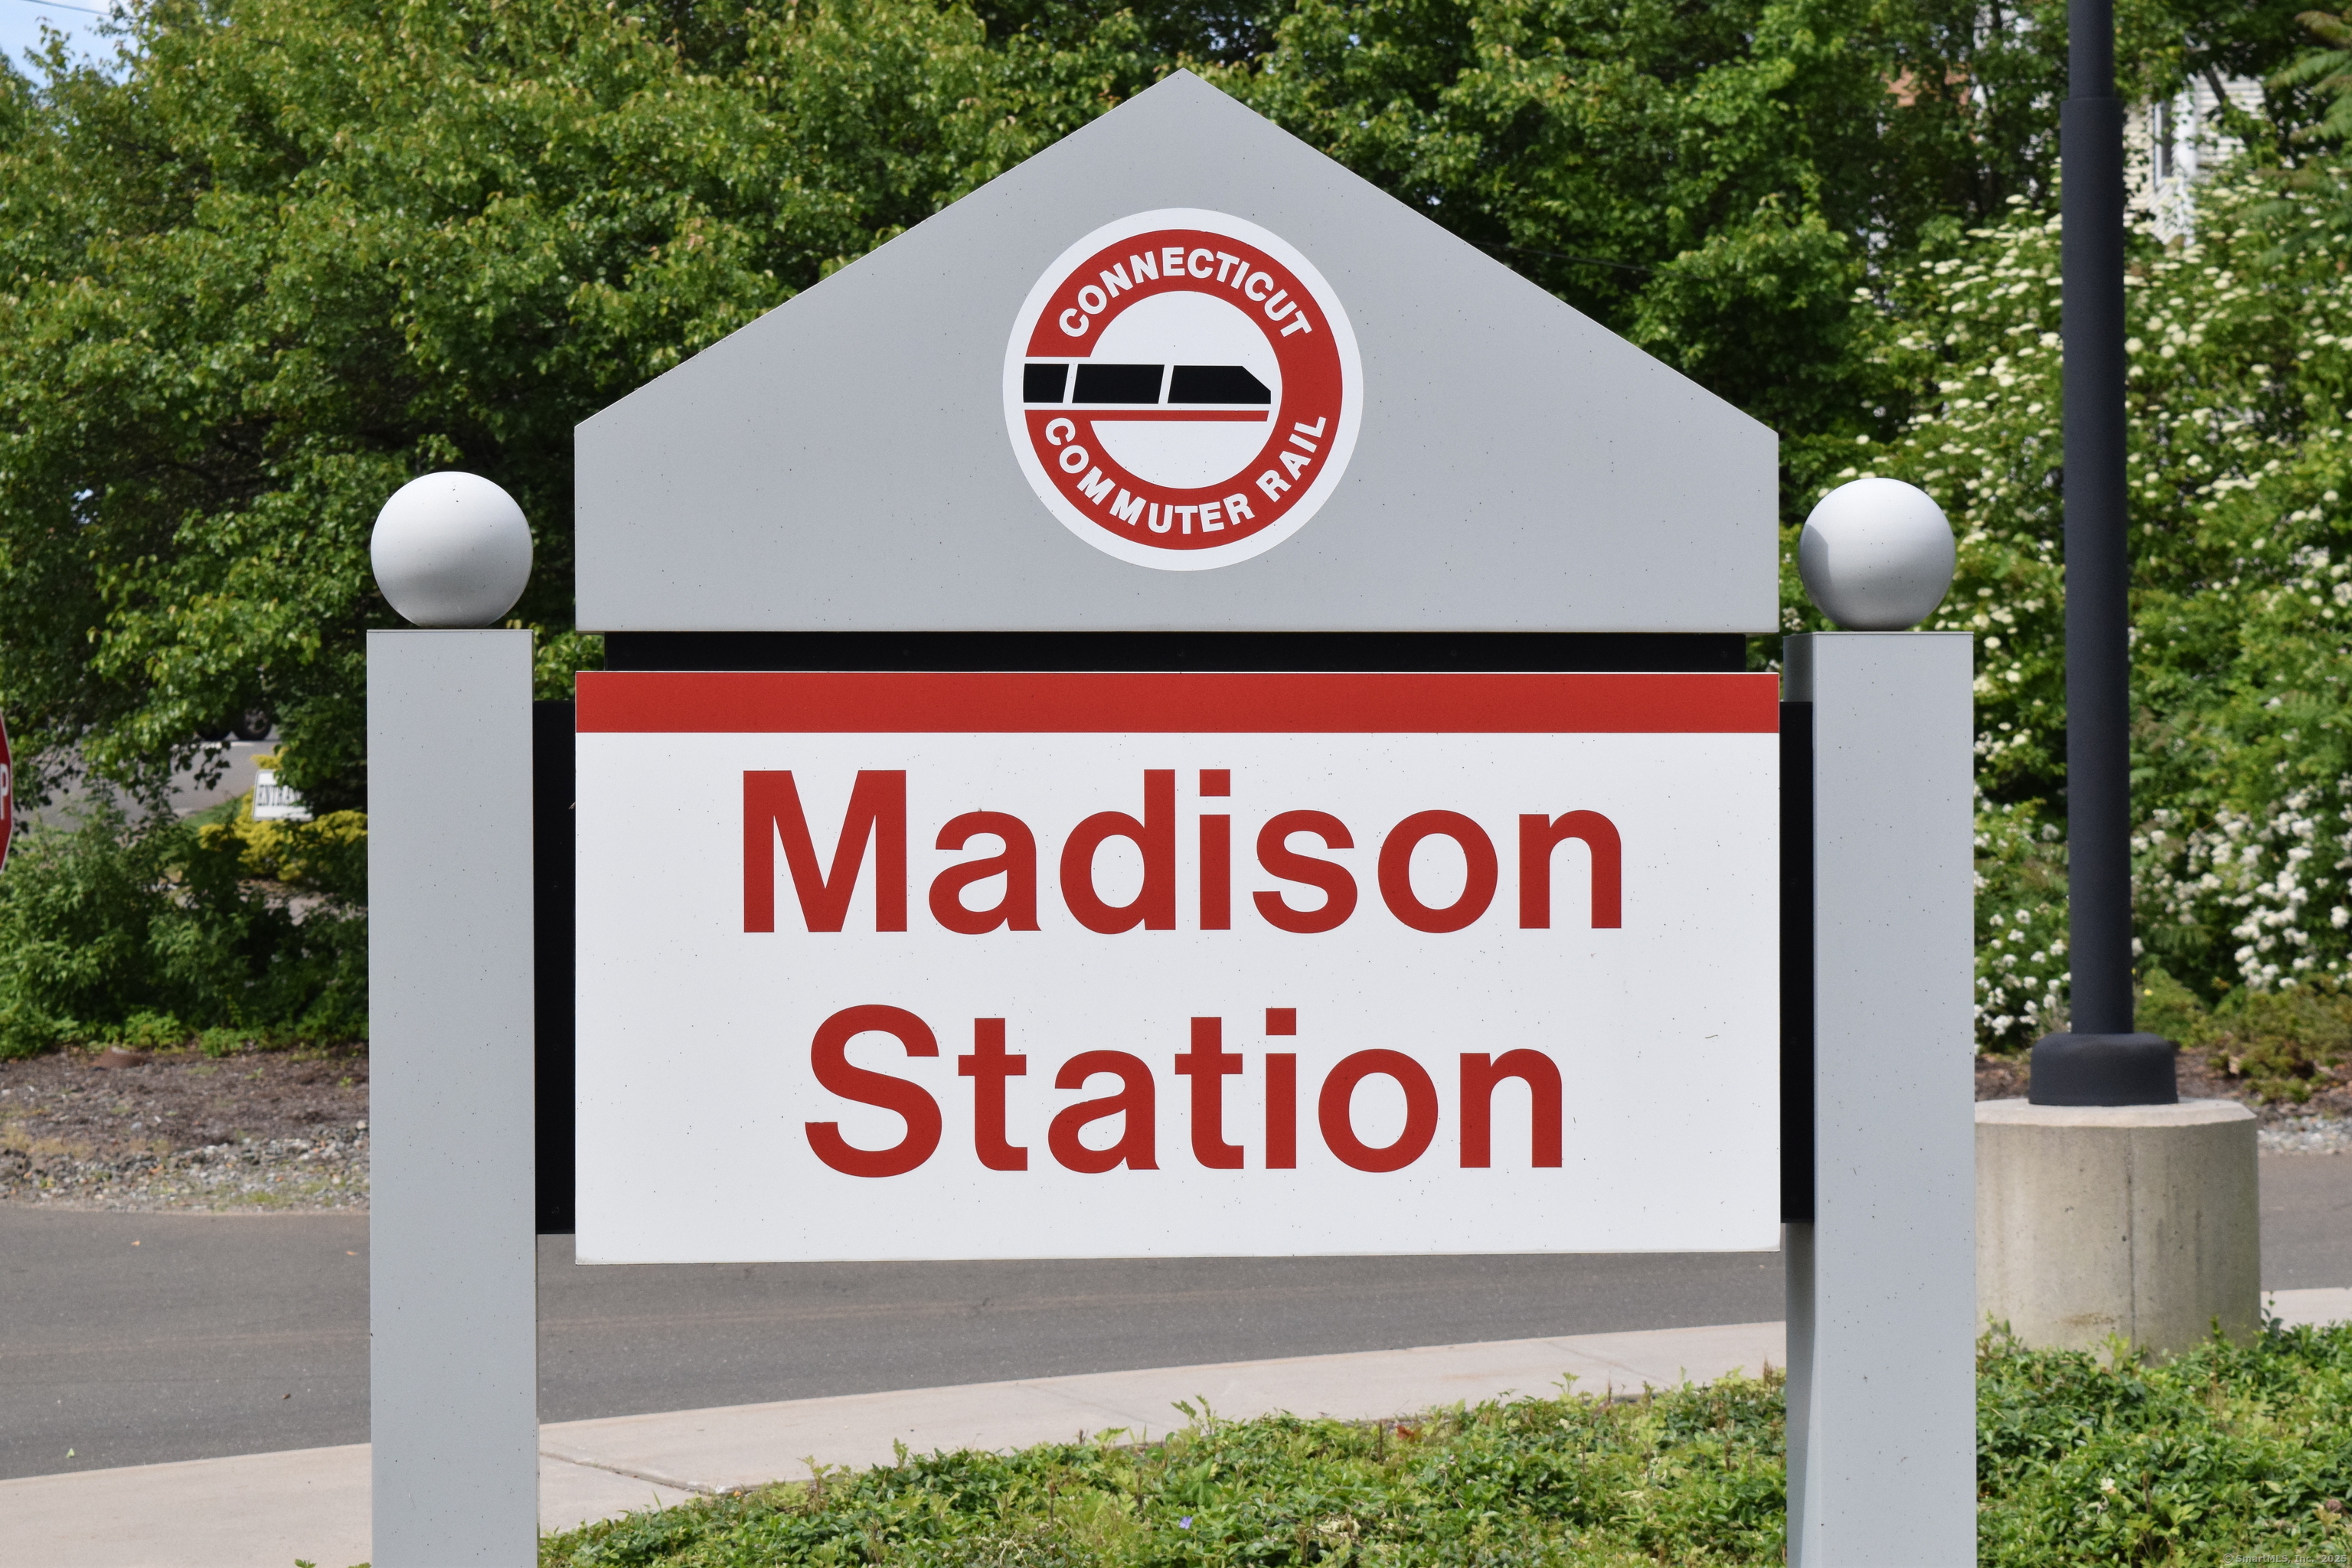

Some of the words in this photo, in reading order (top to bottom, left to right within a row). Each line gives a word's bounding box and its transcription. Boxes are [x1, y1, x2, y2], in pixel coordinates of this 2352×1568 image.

[1058, 247, 1313, 338] CONNECTICUT
[1045, 416, 1256, 534] COMMUTER
[1256, 416, 1327, 503] RAIL
[743, 769, 1622, 935] Madison
[805, 1004, 1563, 1178] Station
